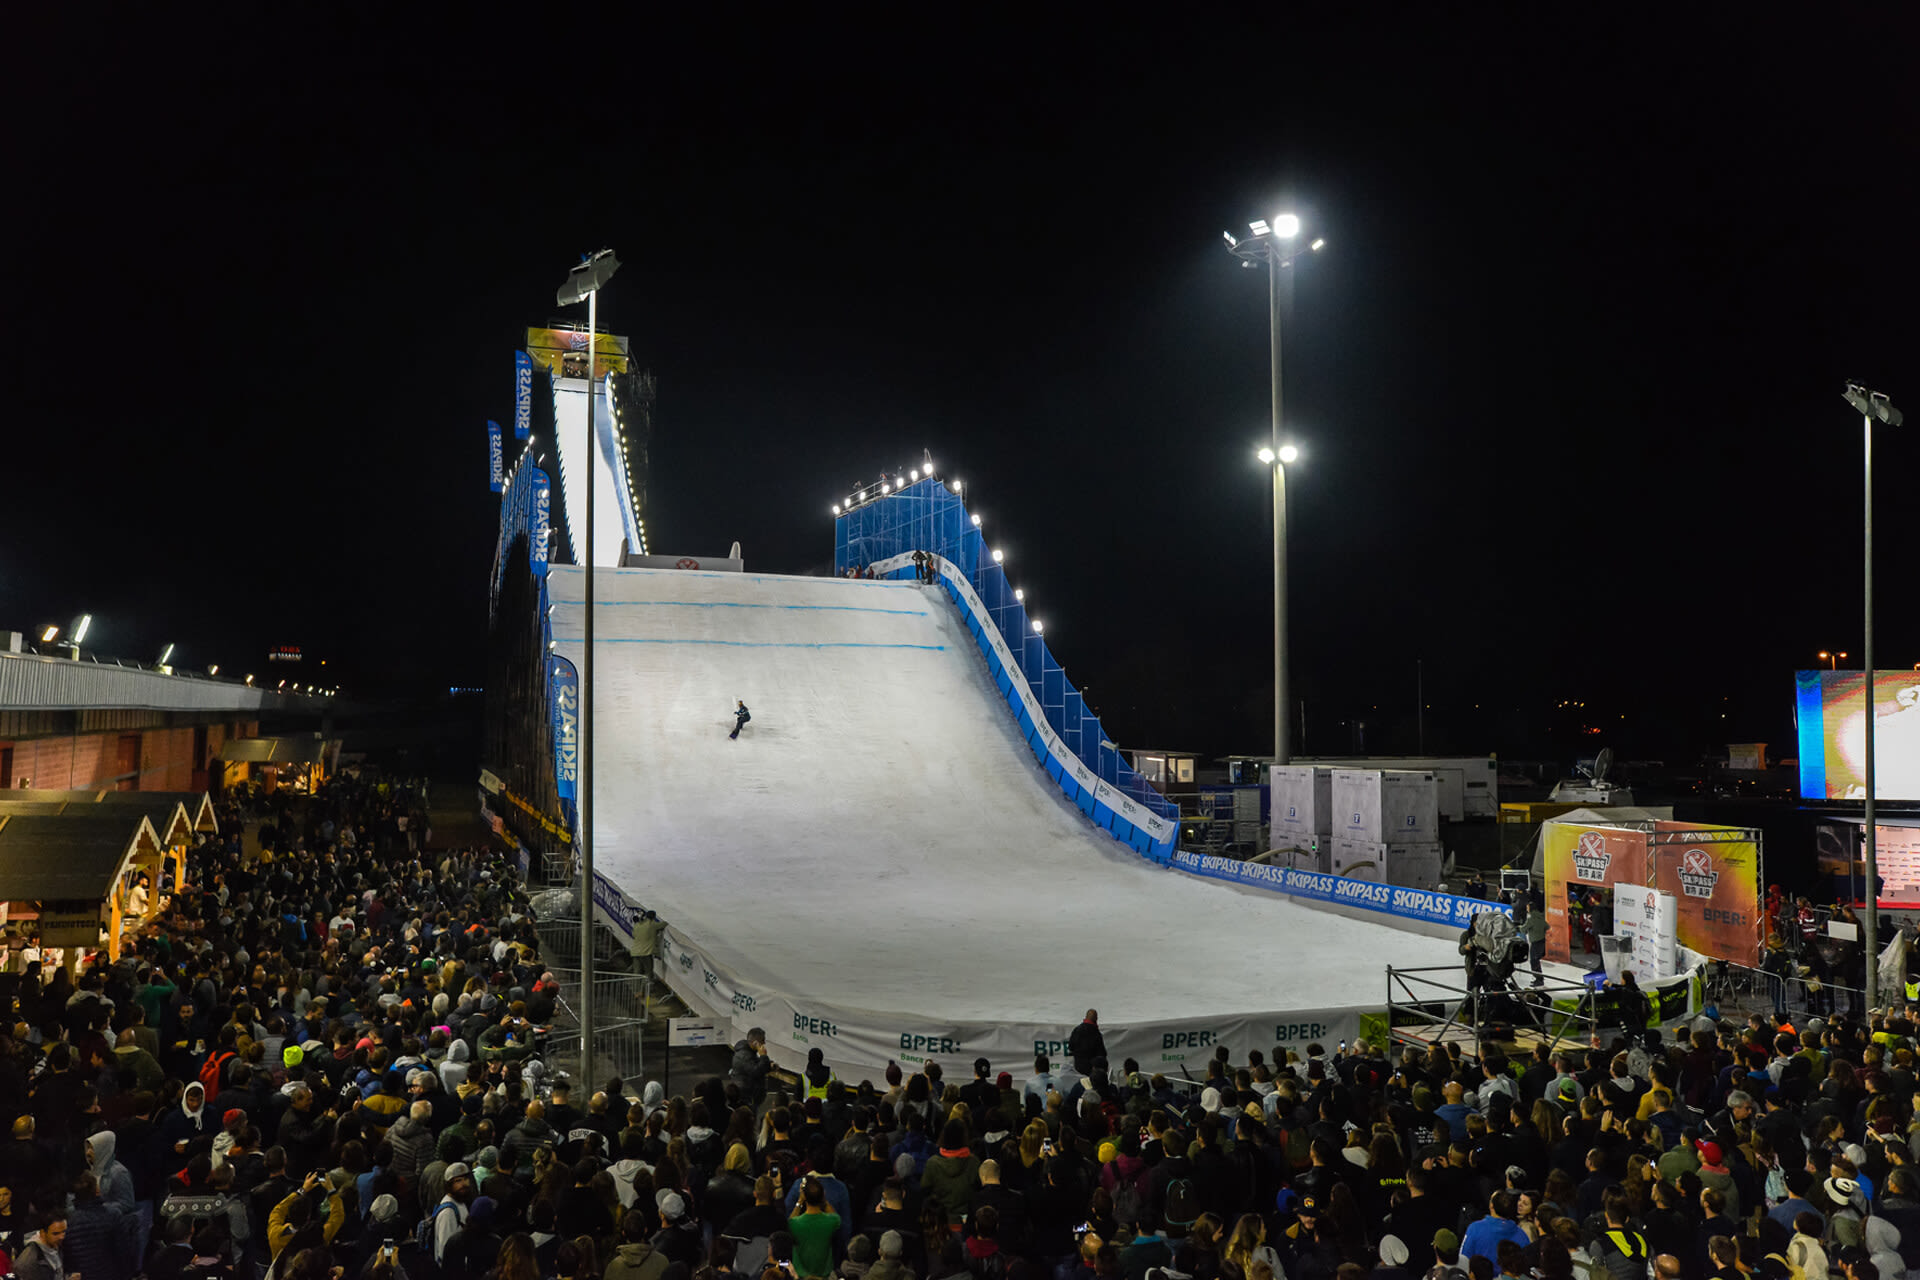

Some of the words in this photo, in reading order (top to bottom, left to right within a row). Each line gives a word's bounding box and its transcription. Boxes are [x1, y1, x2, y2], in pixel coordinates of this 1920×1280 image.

[1577, 857, 1605, 869] SKIPASS
[1201, 856, 1240, 874] SKIPASS
[1240, 863, 1284, 883] SKIPASS
[1286, 871, 1333, 892] SKIPASS
[1335, 880, 1390, 903] SKIPASS
[1392, 890, 1451, 914] SKIPASS
[1684, 875, 1712, 886] SKIPASS
[793, 1012, 837, 1037] BPER:
[1276, 1023, 1326, 1041] BPER:
[900, 1032, 961, 1054] BPER:
[1034, 1040, 1072, 1056] BPE
[1162, 1031, 1217, 1049] BPER:
[900, 1053, 924, 1063] Banca
[1161, 1053, 1185, 1062] Banca
